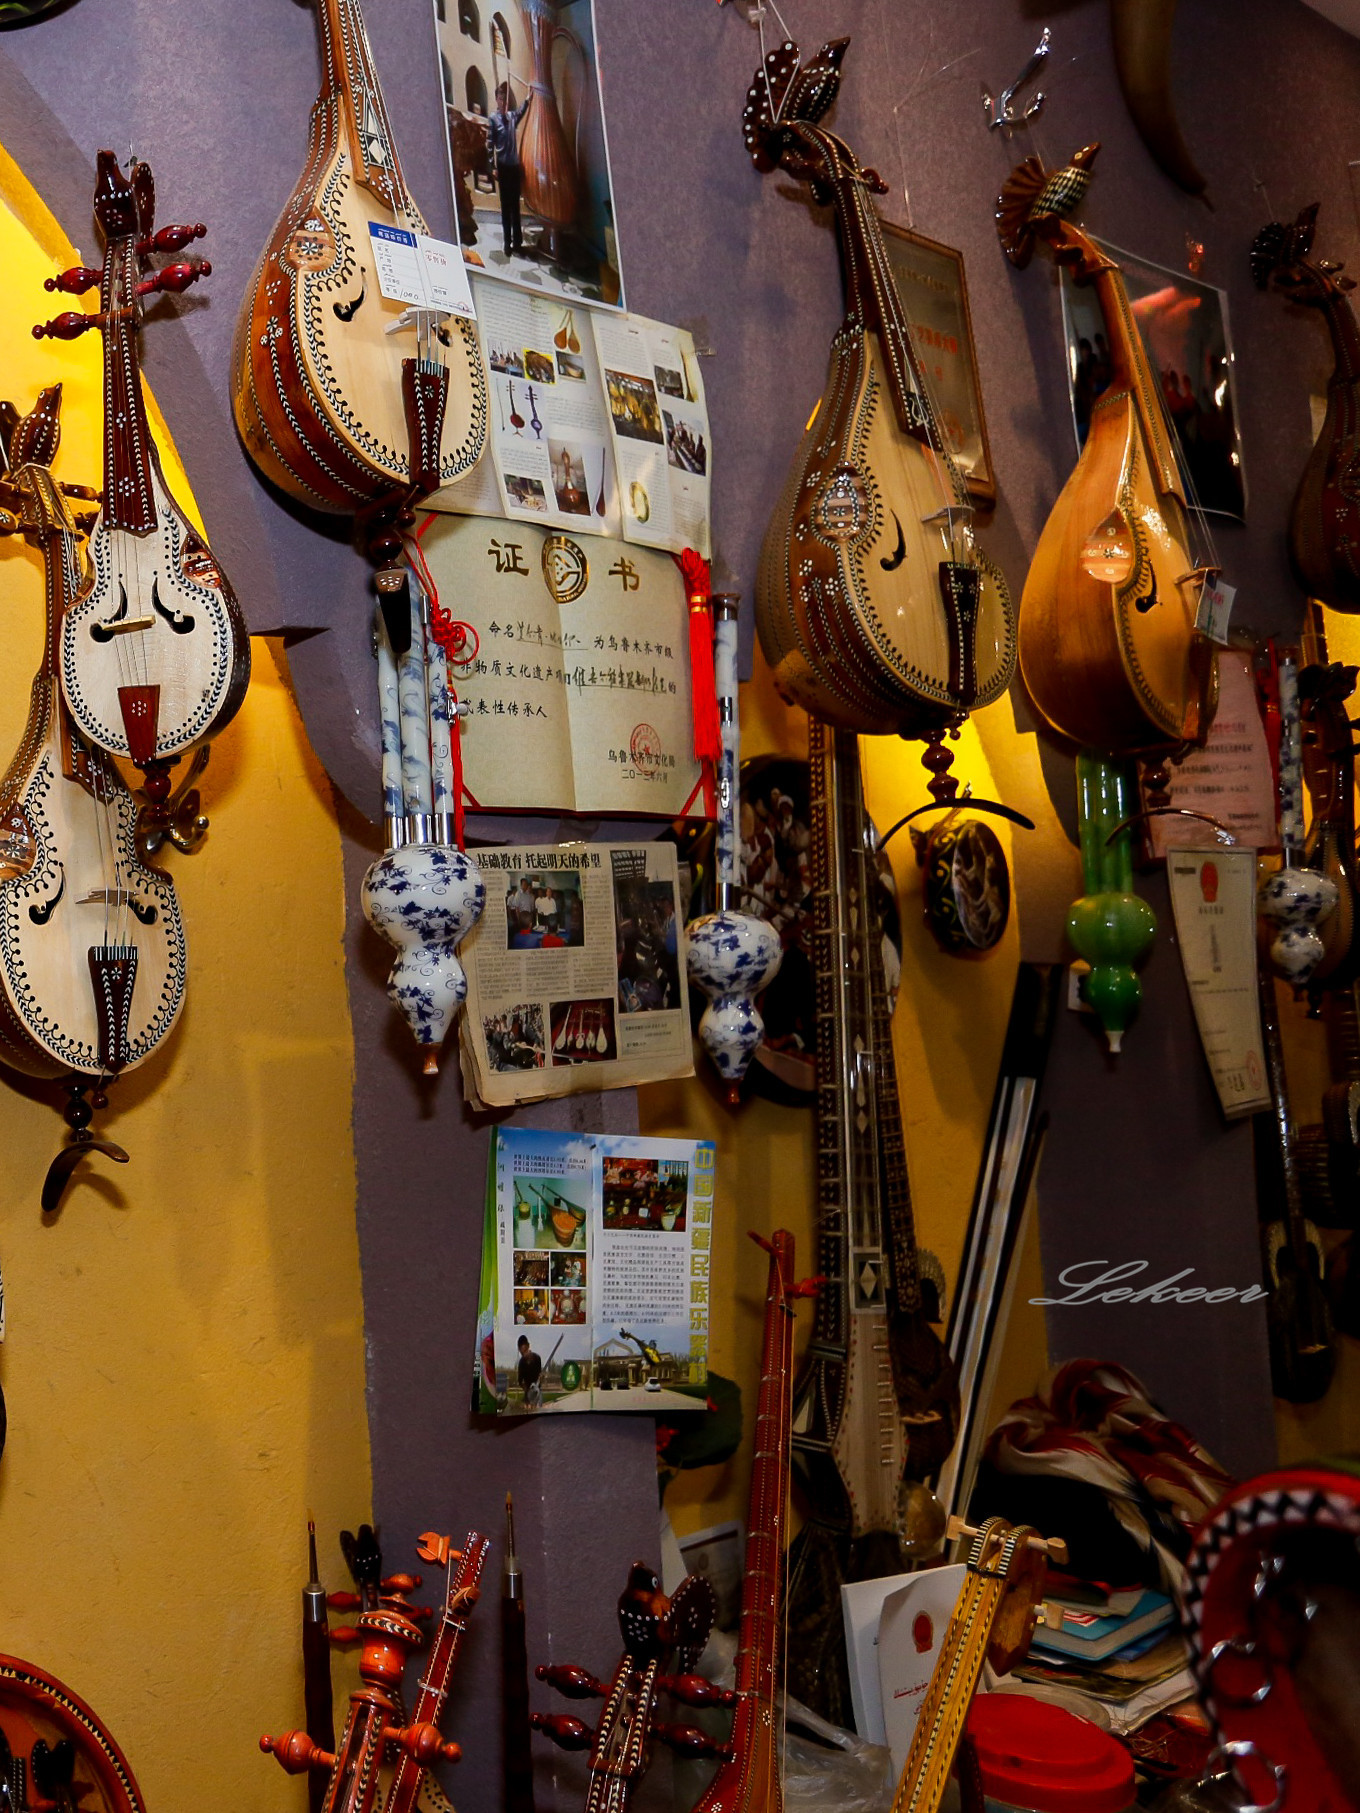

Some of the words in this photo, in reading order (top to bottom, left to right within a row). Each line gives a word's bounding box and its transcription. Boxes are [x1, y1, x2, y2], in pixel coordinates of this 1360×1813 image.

[488, 538, 530, 576] 证
[608, 556, 640, 591] 书
[476, 852, 522, 871] 基础教育
[525, 852, 601, 871] 托起明天的希望
